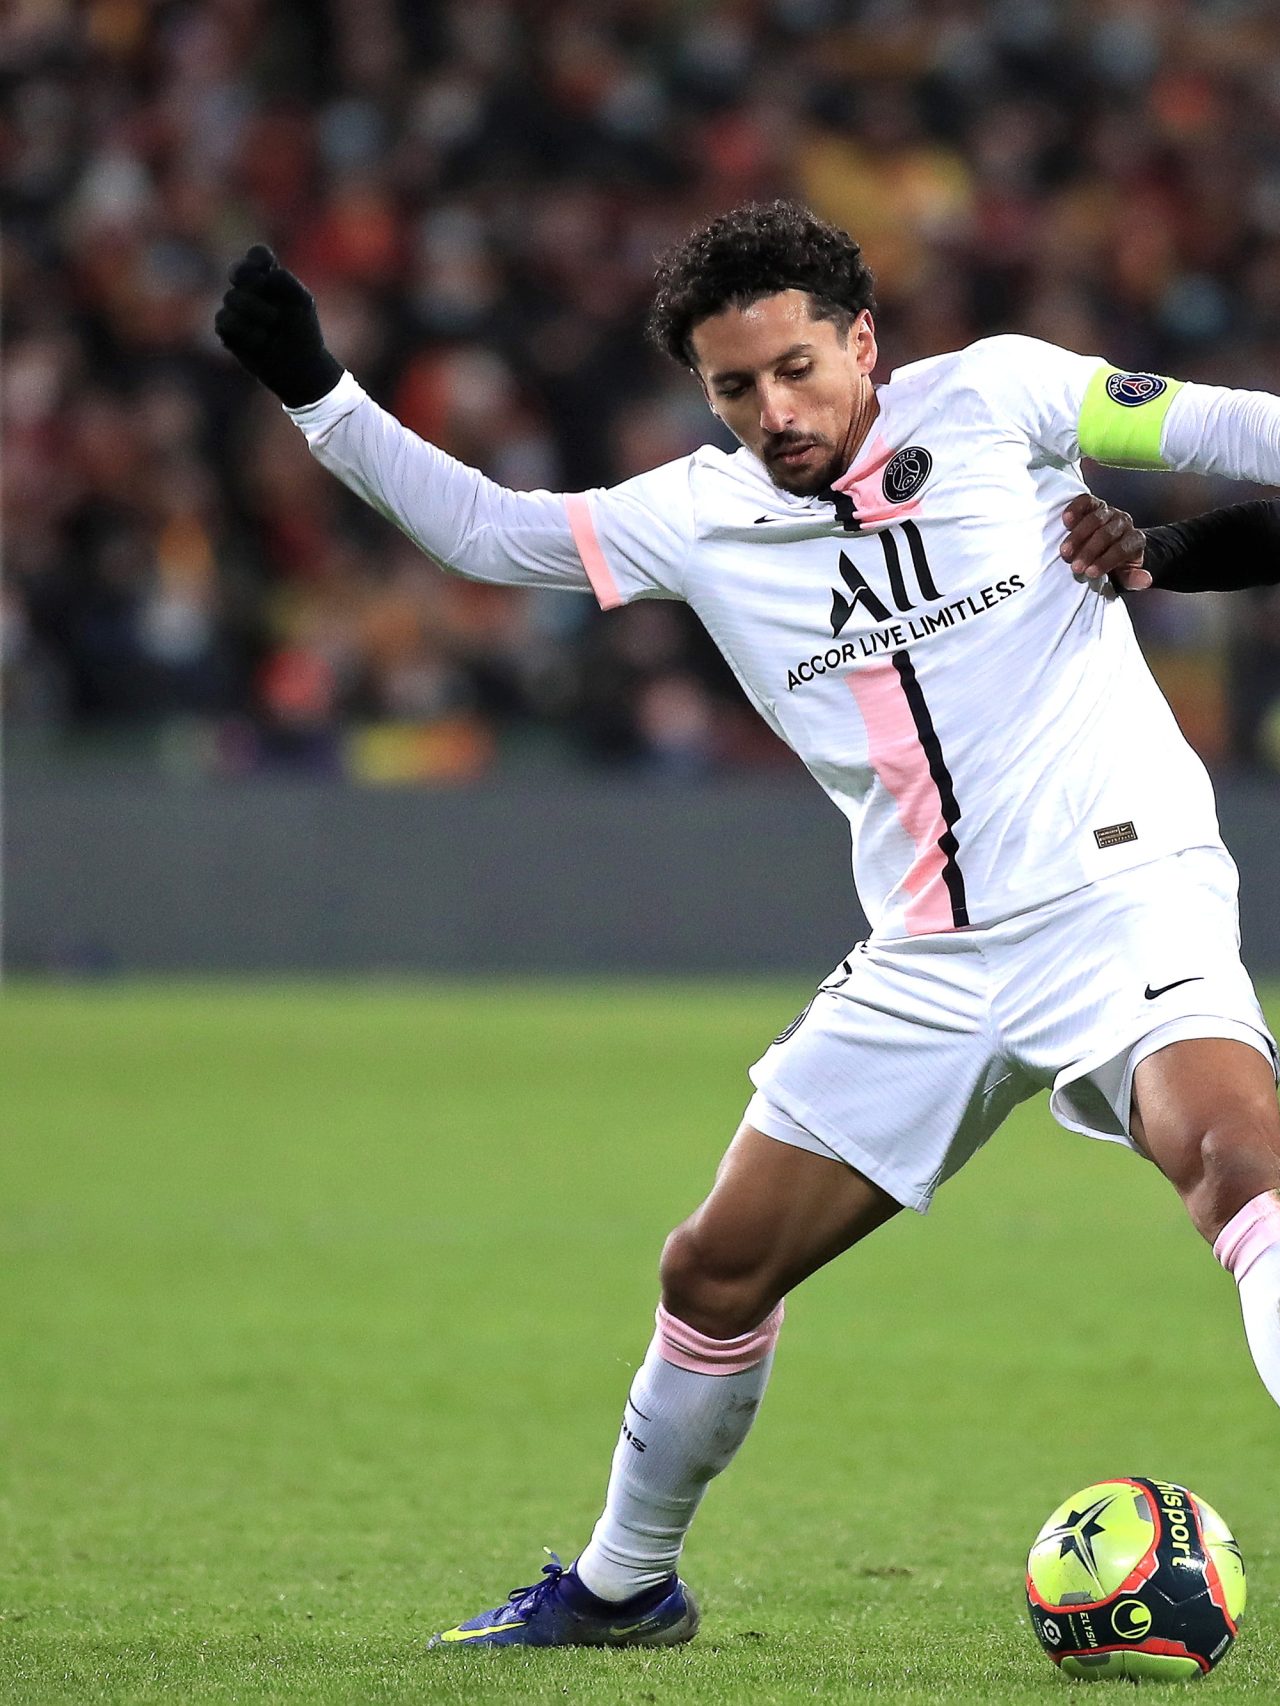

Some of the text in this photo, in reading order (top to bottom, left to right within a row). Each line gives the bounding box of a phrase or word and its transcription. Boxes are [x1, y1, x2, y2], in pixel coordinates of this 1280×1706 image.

[888, 450, 917, 475] PARIS
[787, 575, 1025, 690] ACCOR LIVE LIMITLESS
[1080, 1612, 1099, 1648] ELYSIA
